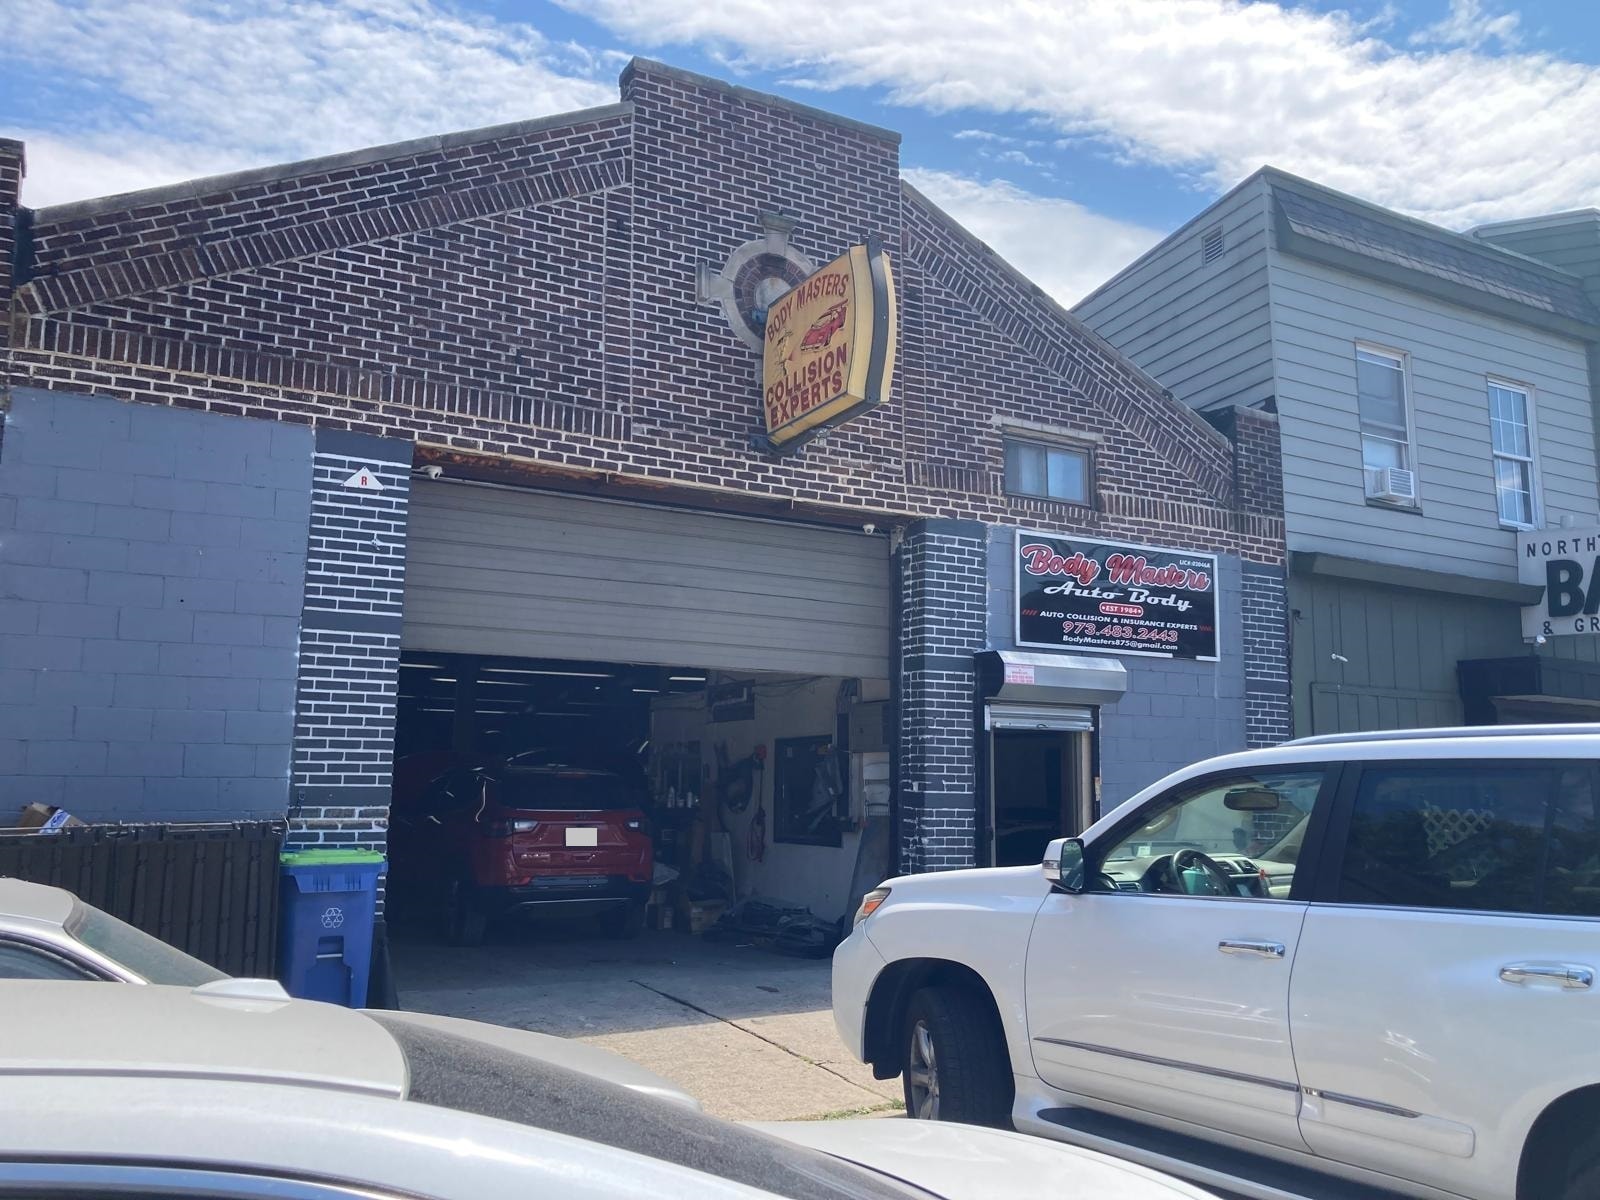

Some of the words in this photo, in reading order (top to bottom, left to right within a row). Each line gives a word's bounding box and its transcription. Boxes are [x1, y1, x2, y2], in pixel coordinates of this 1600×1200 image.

[767, 297, 793, 343] BODY
[796, 274, 849, 312] MASTERS
[766, 343, 848, 408] COLLISION
[770, 370, 843, 428] EXPERTS
[361, 476, 368, 486] R
[1526, 534, 1600, 558] NORTH
[1020, 544, 1101, 586] Body
[1105, 553, 1211, 592] Masters
[1043, 581, 1124, 600] Auto
[1127, 588, 1192, 612] Body
[1039, 610, 1064, 619] AUTO
[1066, 613, 1111, 622] COLLISION
[1120, 618, 1165, 628] INSURANCE
[1166, 622, 1198, 631] EXPERTS
[1120, 606, 1138, 614] 1984
[1062, 621, 1178, 642] 973.483.2443
[1543, 620, 1554, 635] &
[1062, 635, 1178, 651] BodyMasters875@gmail.com
